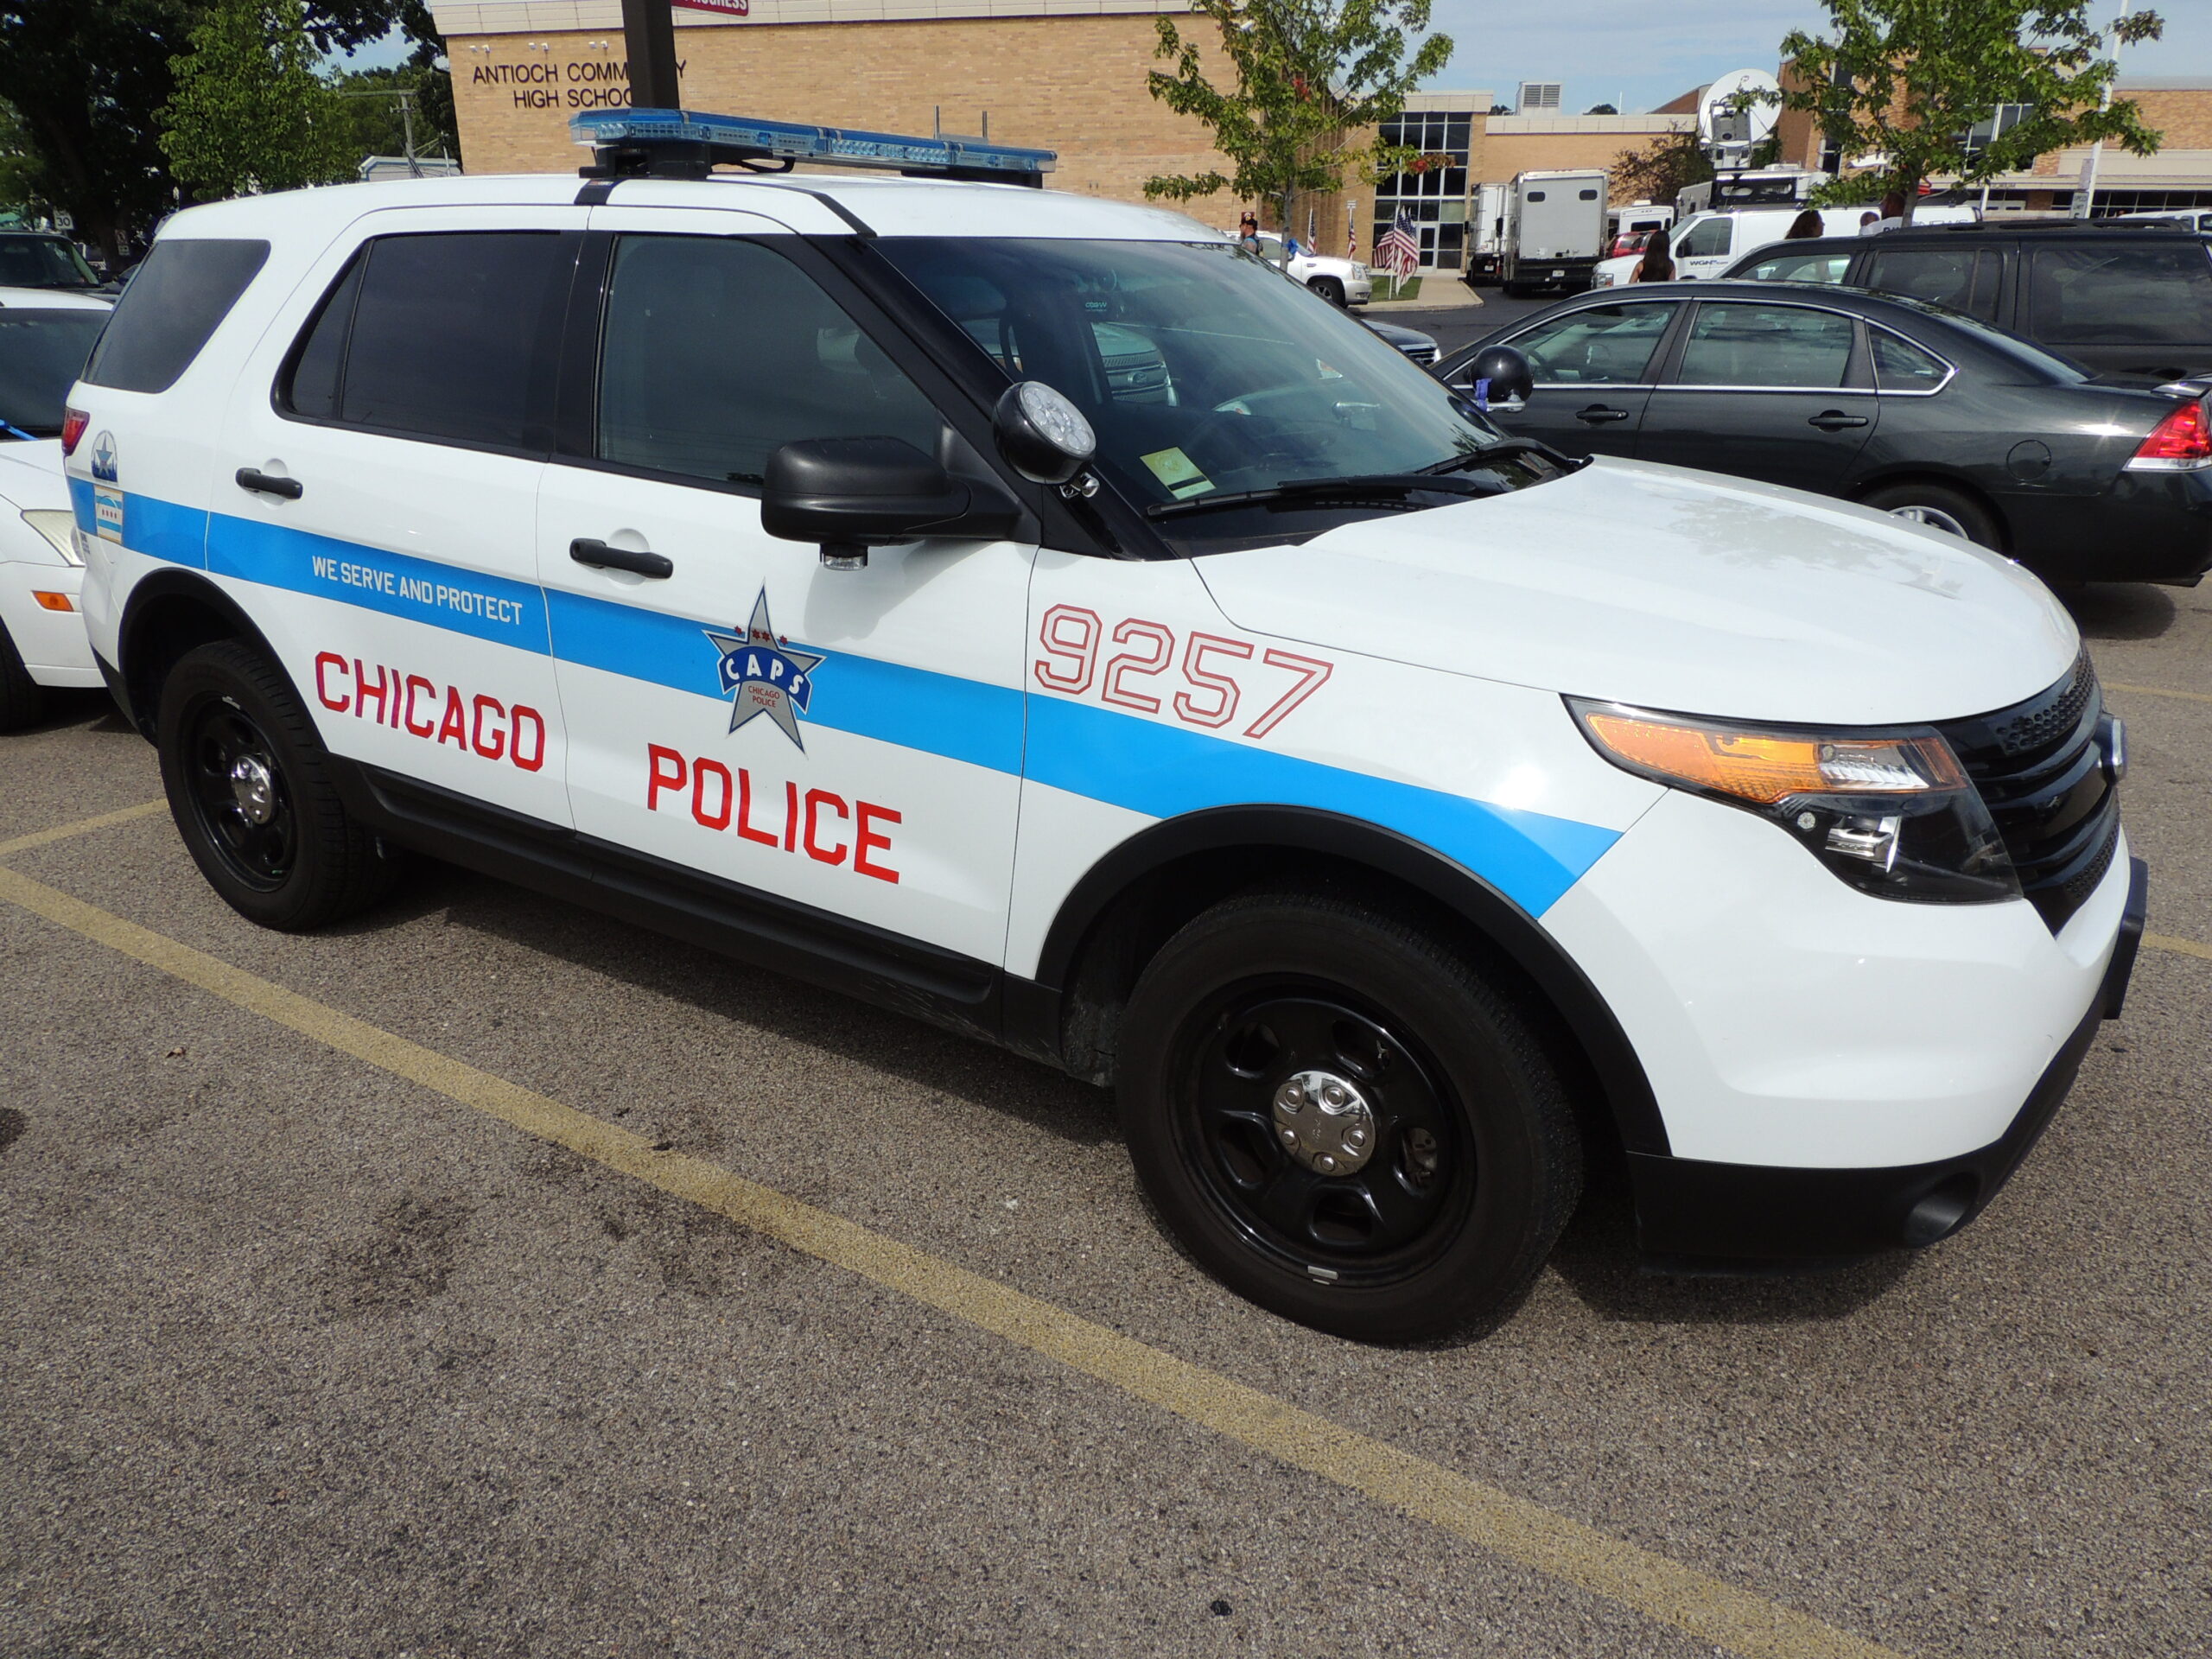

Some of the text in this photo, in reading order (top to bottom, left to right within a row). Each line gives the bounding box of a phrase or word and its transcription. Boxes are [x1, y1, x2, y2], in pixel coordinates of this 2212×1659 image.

[473, 59, 687, 85] ANTIOCH COMMY
[513, 87, 632, 109] HIGH SCHOO
[56, 217, 70, 226] 30
[312, 555, 523, 625] WE SERVE AND PROTECT
[726, 653, 804, 694] CAPS
[1034, 603, 1334, 740] 9257
[747, 685, 780, 699] CHICAGO
[752, 695, 776, 708] POLICE
[315, 651, 546, 772] CHICAGO
[647, 742, 902, 885] POLICE
